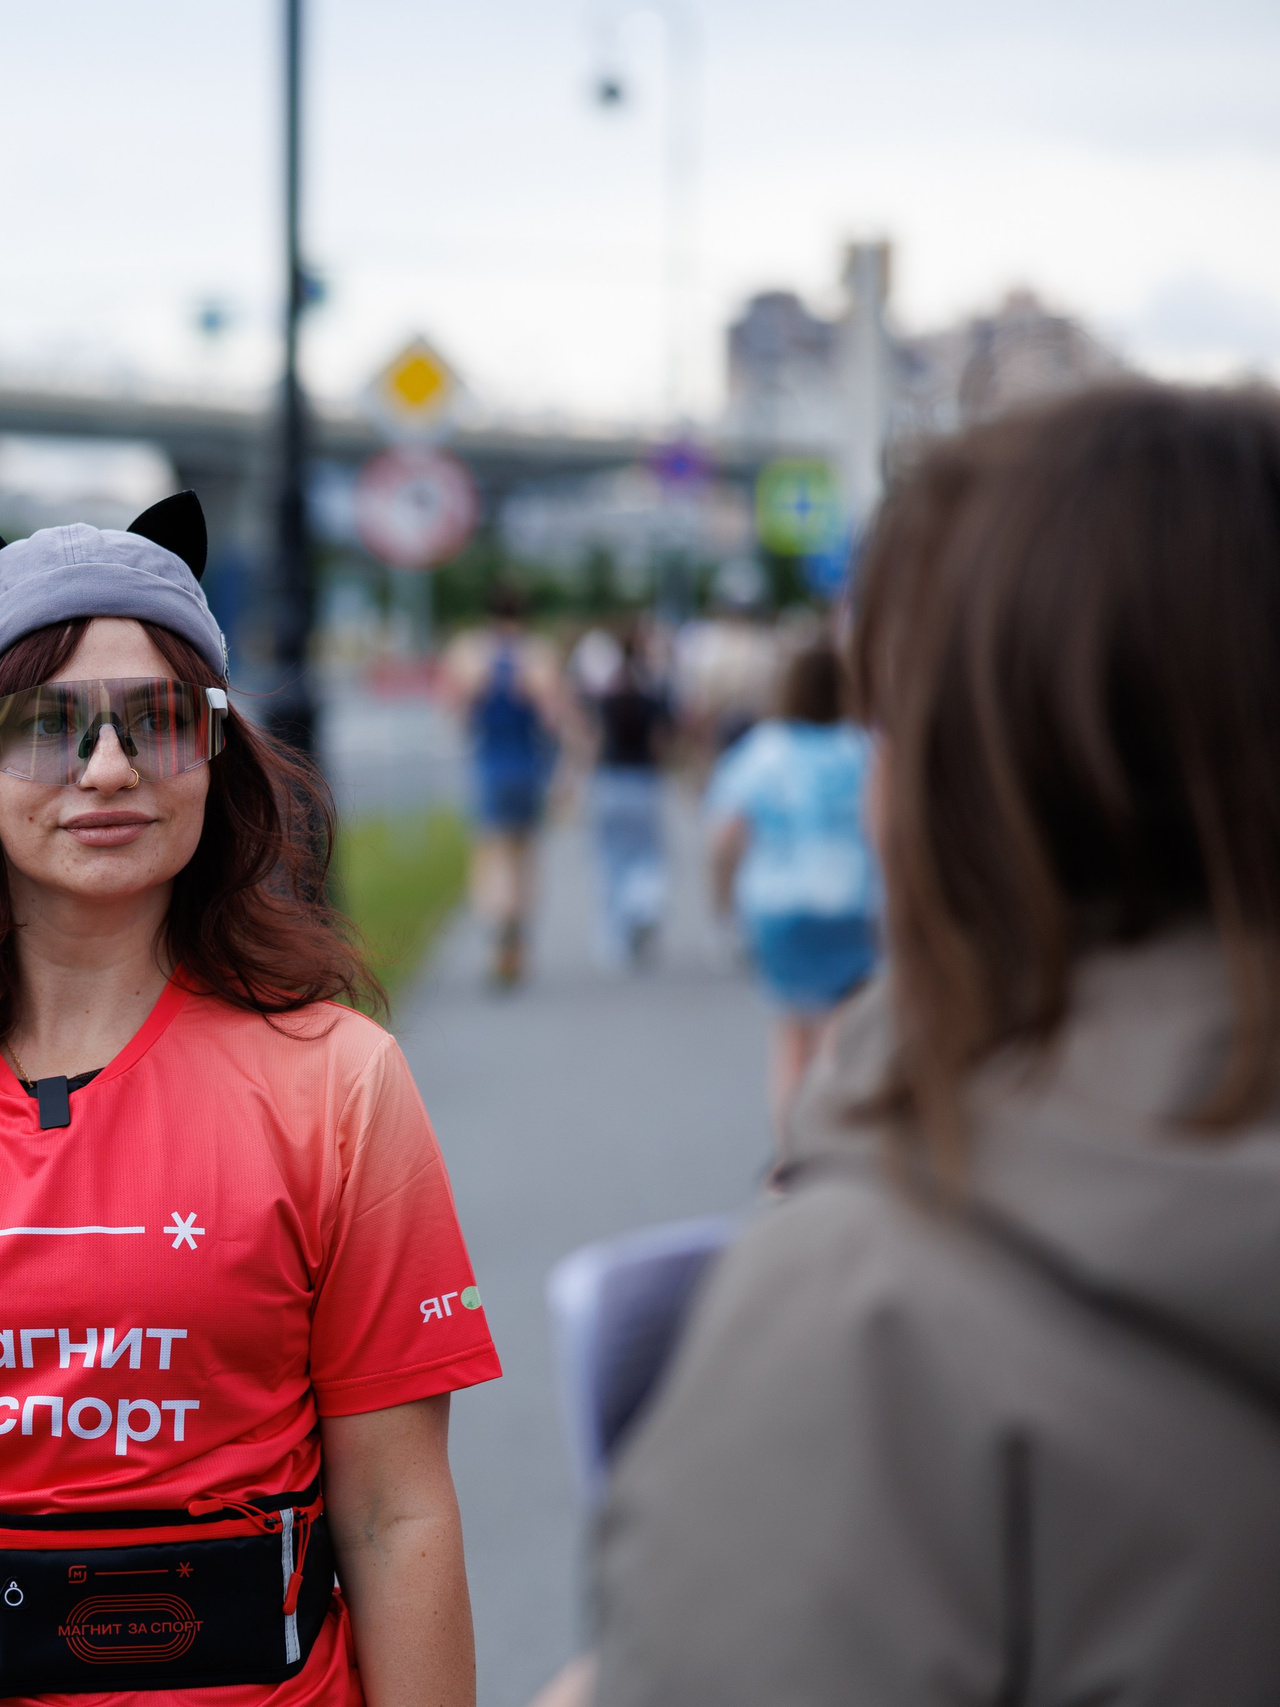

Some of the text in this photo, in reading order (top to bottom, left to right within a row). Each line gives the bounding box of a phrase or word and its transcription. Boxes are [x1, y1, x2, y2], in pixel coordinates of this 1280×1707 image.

[58, 1620, 204, 1637] МАГНИТ ЗА СПОРТ
